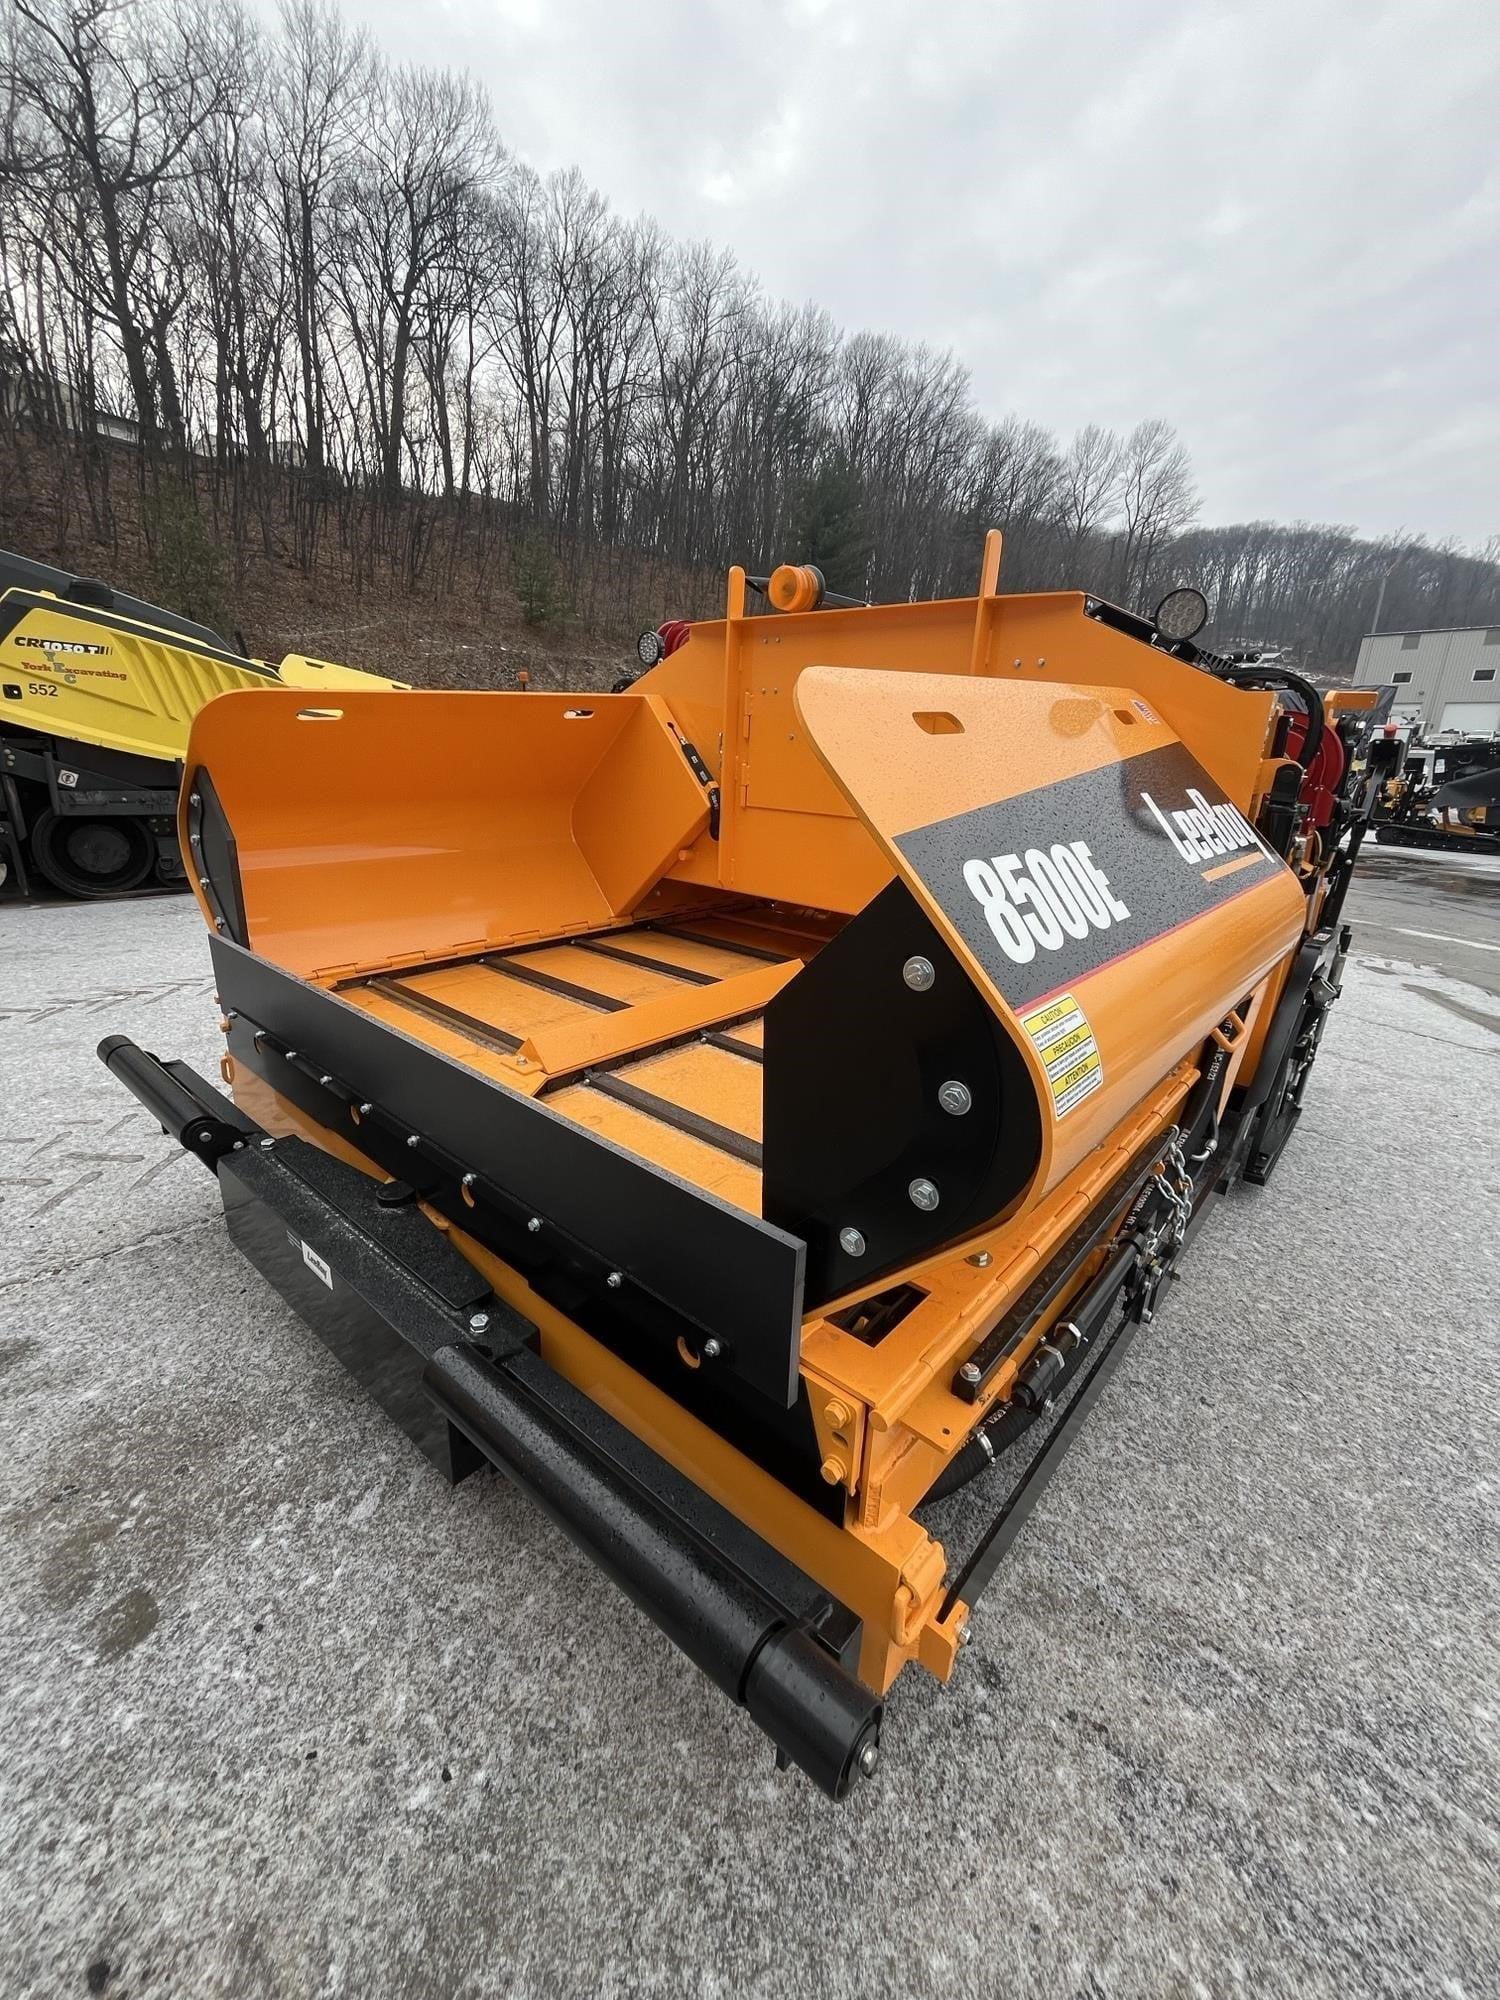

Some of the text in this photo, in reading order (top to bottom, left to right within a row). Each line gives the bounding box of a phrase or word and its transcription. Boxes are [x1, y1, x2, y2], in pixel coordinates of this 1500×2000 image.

[21, 661, 128, 681] York Excavating
[28, 683, 58, 697] 552
[1140, 788, 1276, 865] LeeBoy
[962, 840, 1132, 964] 8500E
[1040, 1006, 1064, 1025] CAUTION
[1064, 1062, 1089, 1086] ATTENTION
